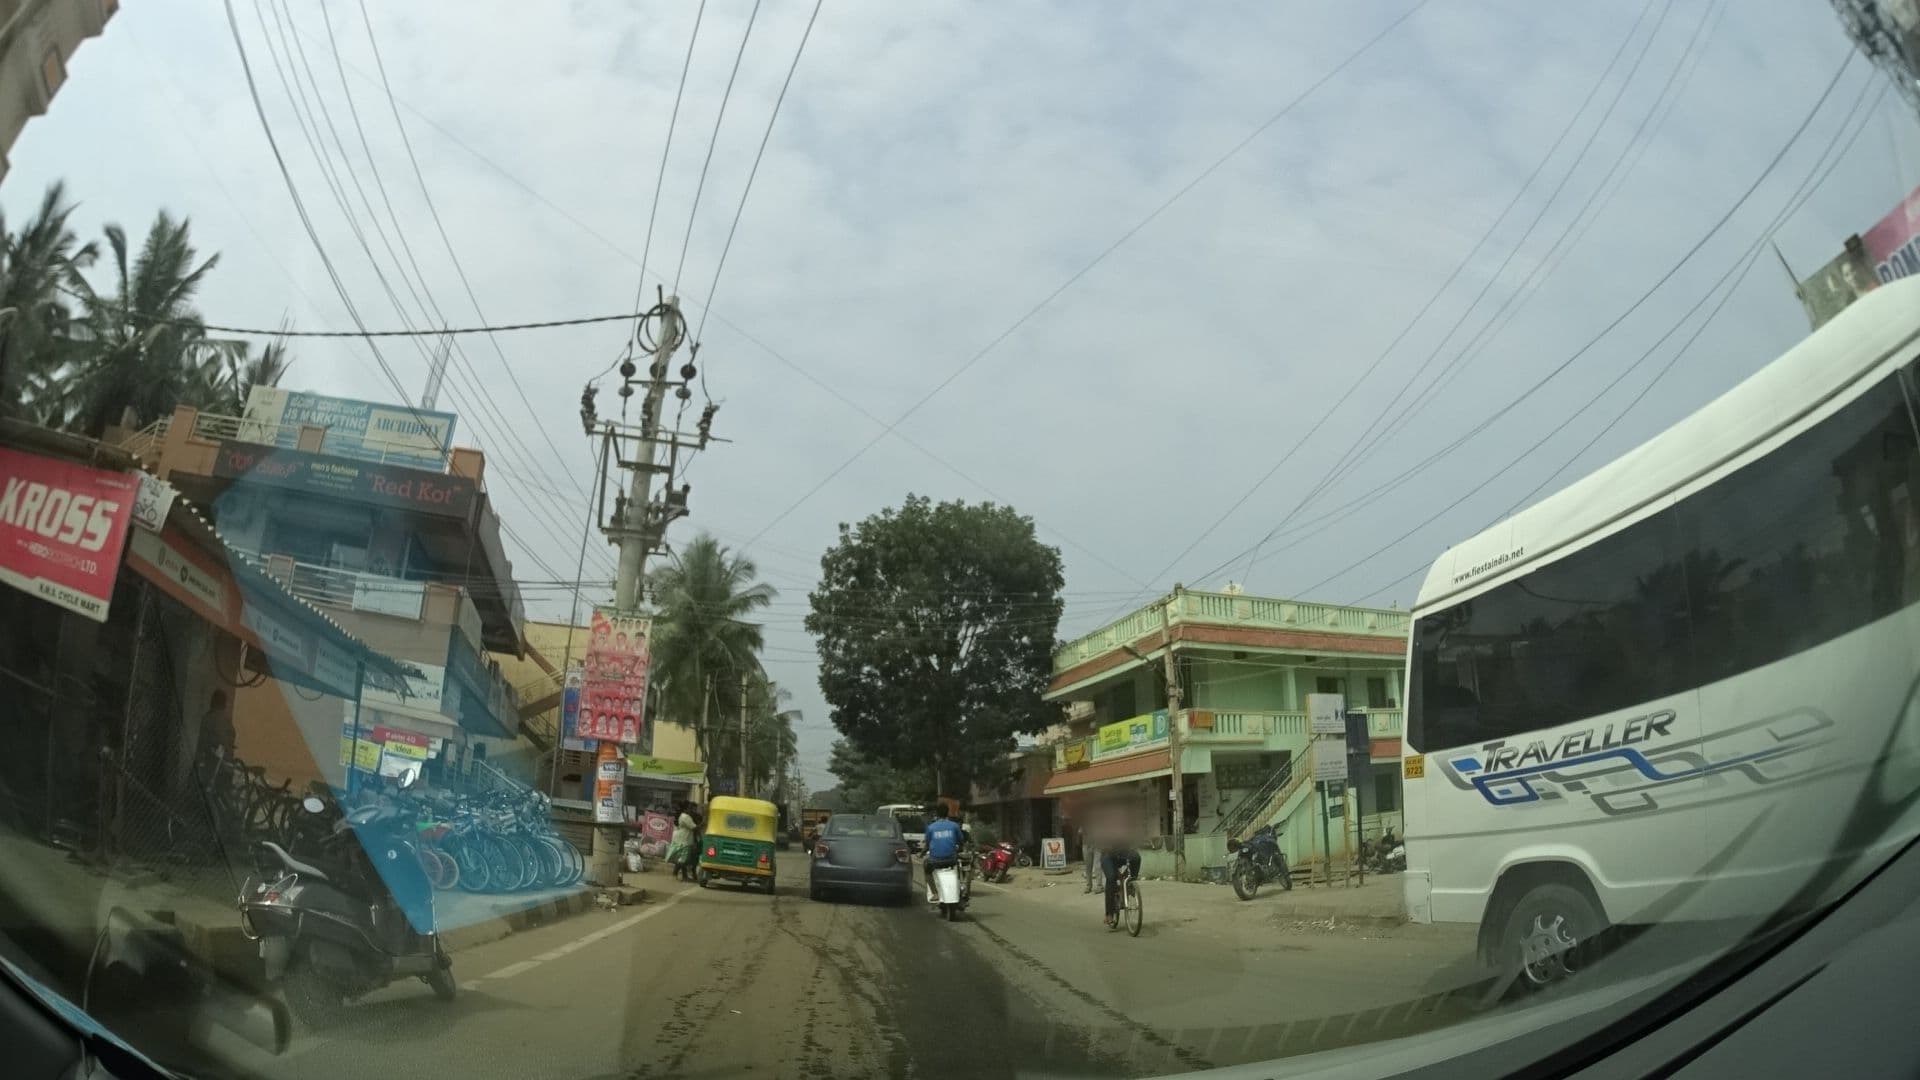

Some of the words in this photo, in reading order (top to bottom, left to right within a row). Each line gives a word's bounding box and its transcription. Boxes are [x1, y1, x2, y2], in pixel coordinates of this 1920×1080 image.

[299, 408, 367, 429] MARKETING
[0, 477, 119, 552] KROSS
[1453, 546, 1524, 584] www.fiestaindia.net
[80, 598, 102, 613] MART
[1481, 707, 1677, 774] TRAVELLER
